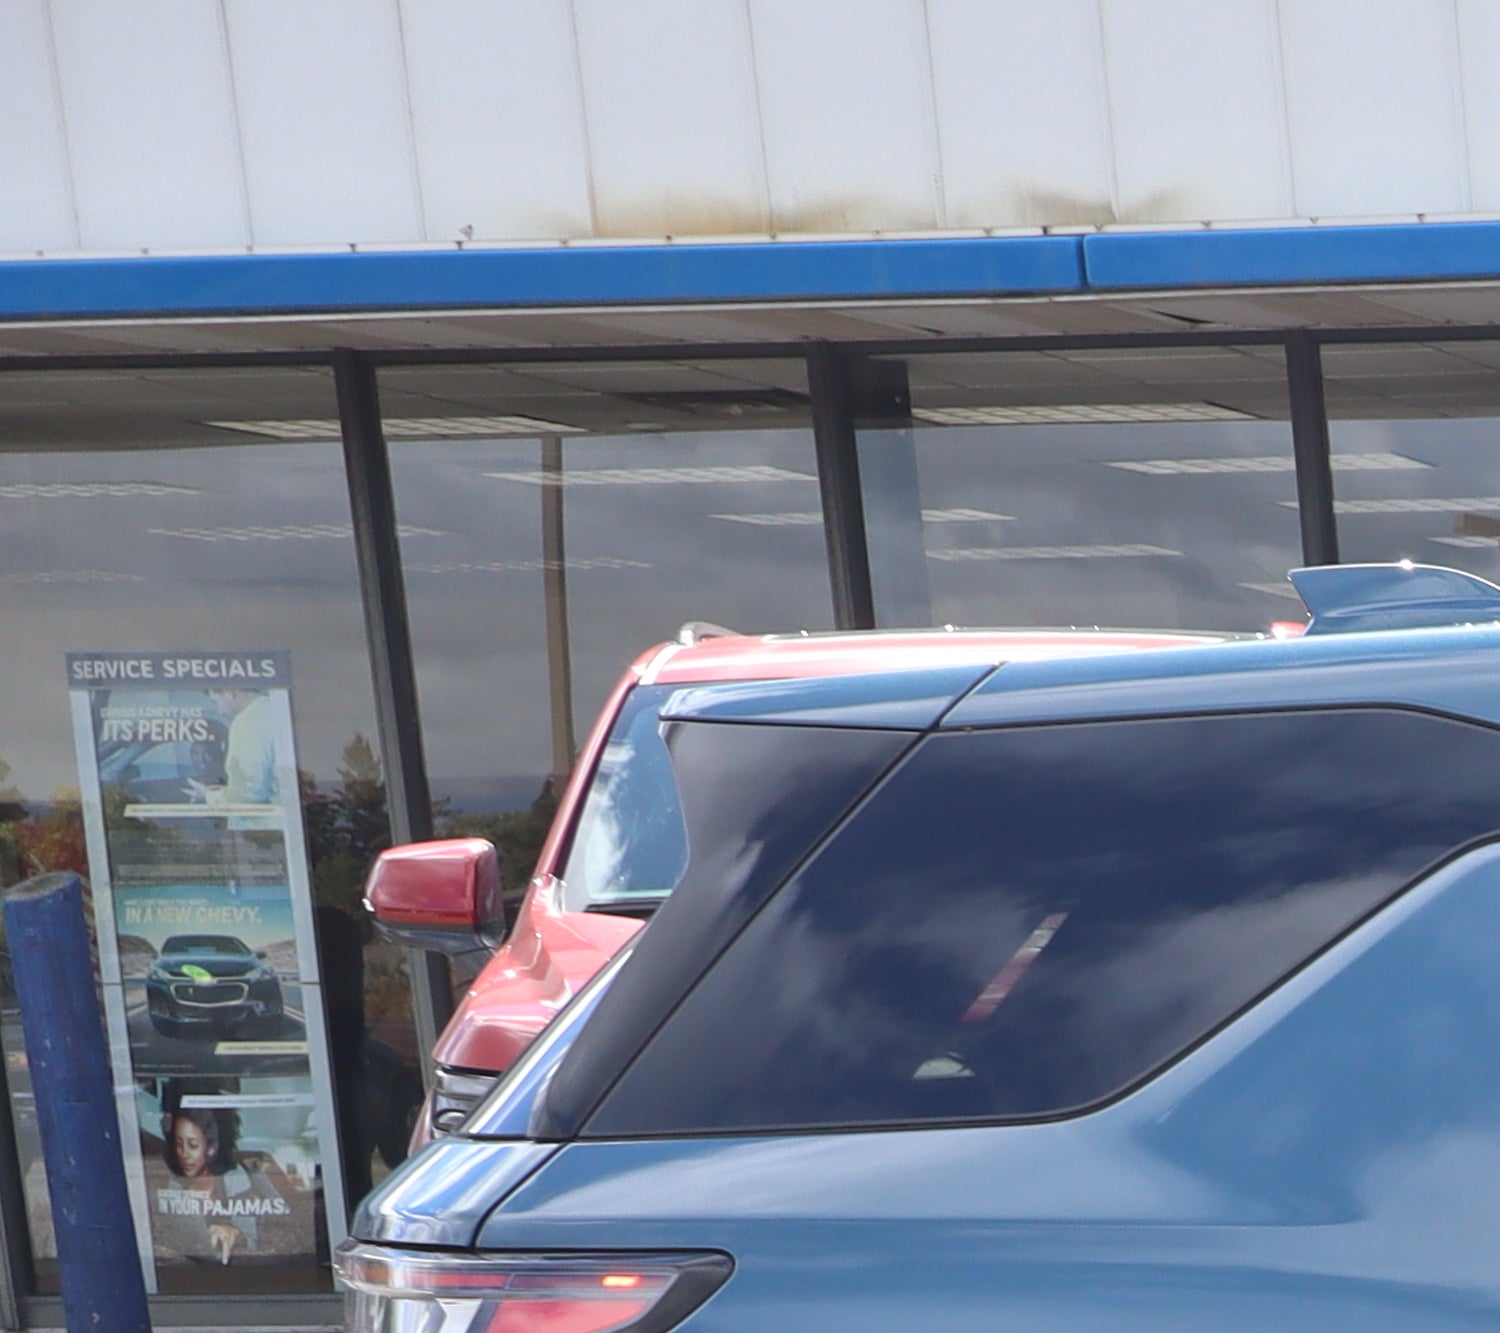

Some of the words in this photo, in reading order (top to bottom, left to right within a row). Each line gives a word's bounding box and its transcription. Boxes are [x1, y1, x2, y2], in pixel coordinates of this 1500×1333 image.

[72, 659, 154, 679] SERVICE
[162, 658, 277, 678] SPECIALS
[102, 719, 134, 742] ITS
[137, 719, 215, 742] PERKS.
[125, 906, 141, 923] IN
[144, 906, 153, 923] A
[157, 906, 192, 923] NEW
[195, 906, 263, 924] CHEVY.
[169, 1199, 200, 1215] YOUR
[203, 1198, 291, 1216] PAJAMAS.
